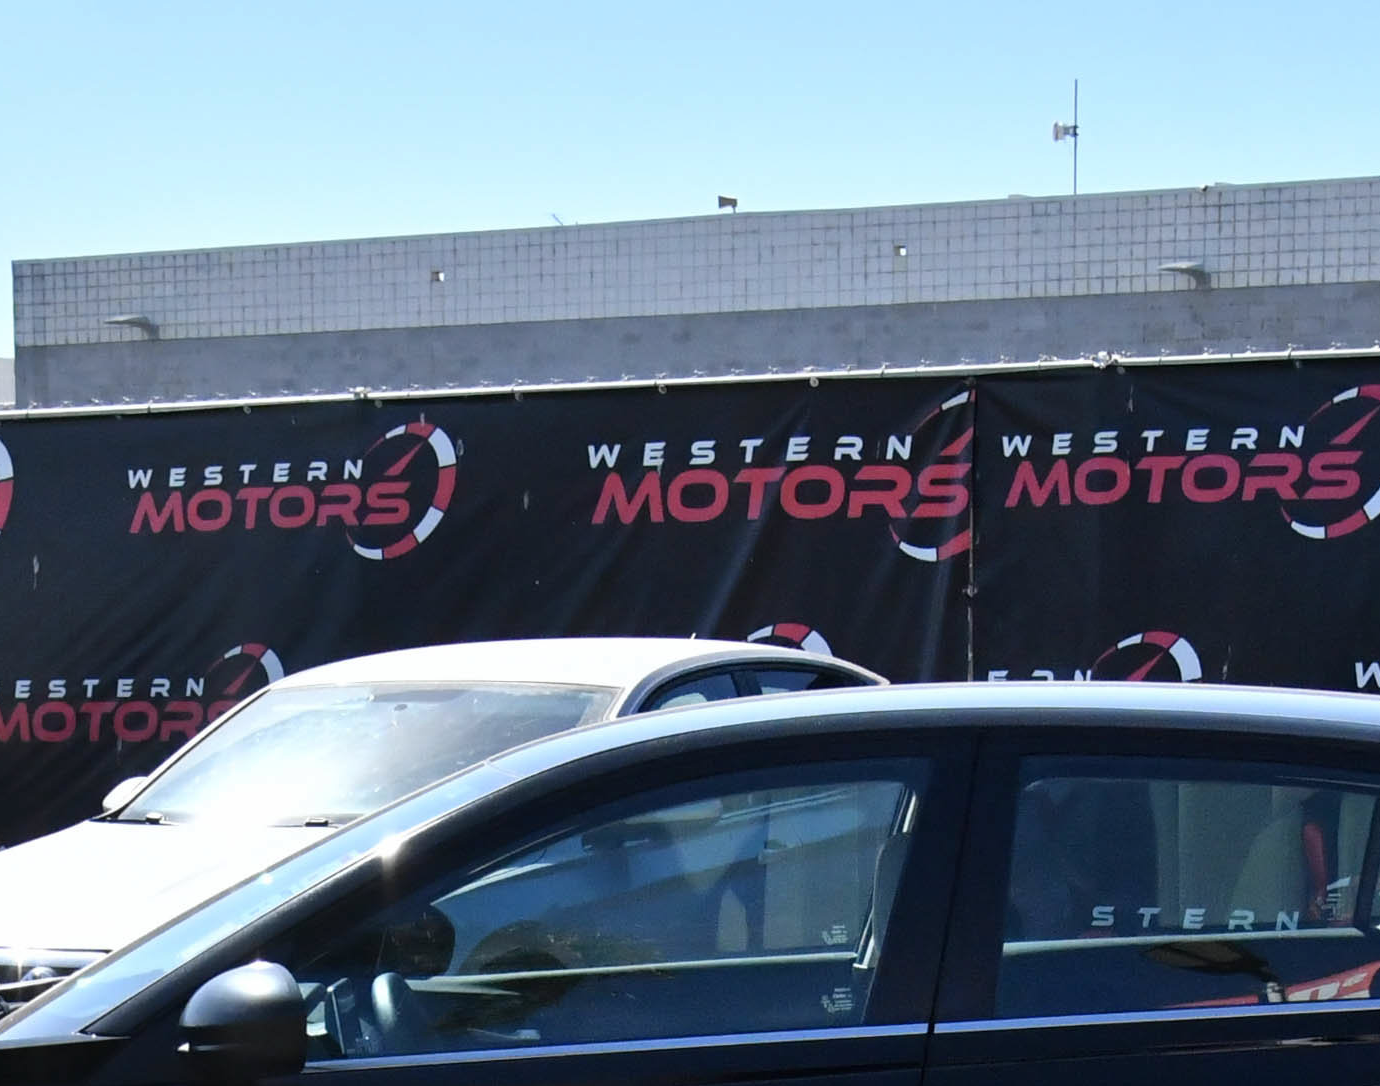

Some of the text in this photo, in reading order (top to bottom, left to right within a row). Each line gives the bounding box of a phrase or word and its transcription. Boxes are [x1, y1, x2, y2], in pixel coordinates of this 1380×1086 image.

[587, 435, 913, 469] WESTERN
[1002, 425, 1305, 458] WESTERN
[127, 459, 363, 489] WESTERN
[1005, 450, 1362, 508] MOTORS
[130, 481, 410, 533] MOTORS
[592, 463, 971, 524] MOTORS
[1091, 905, 1300, 930] STERN
